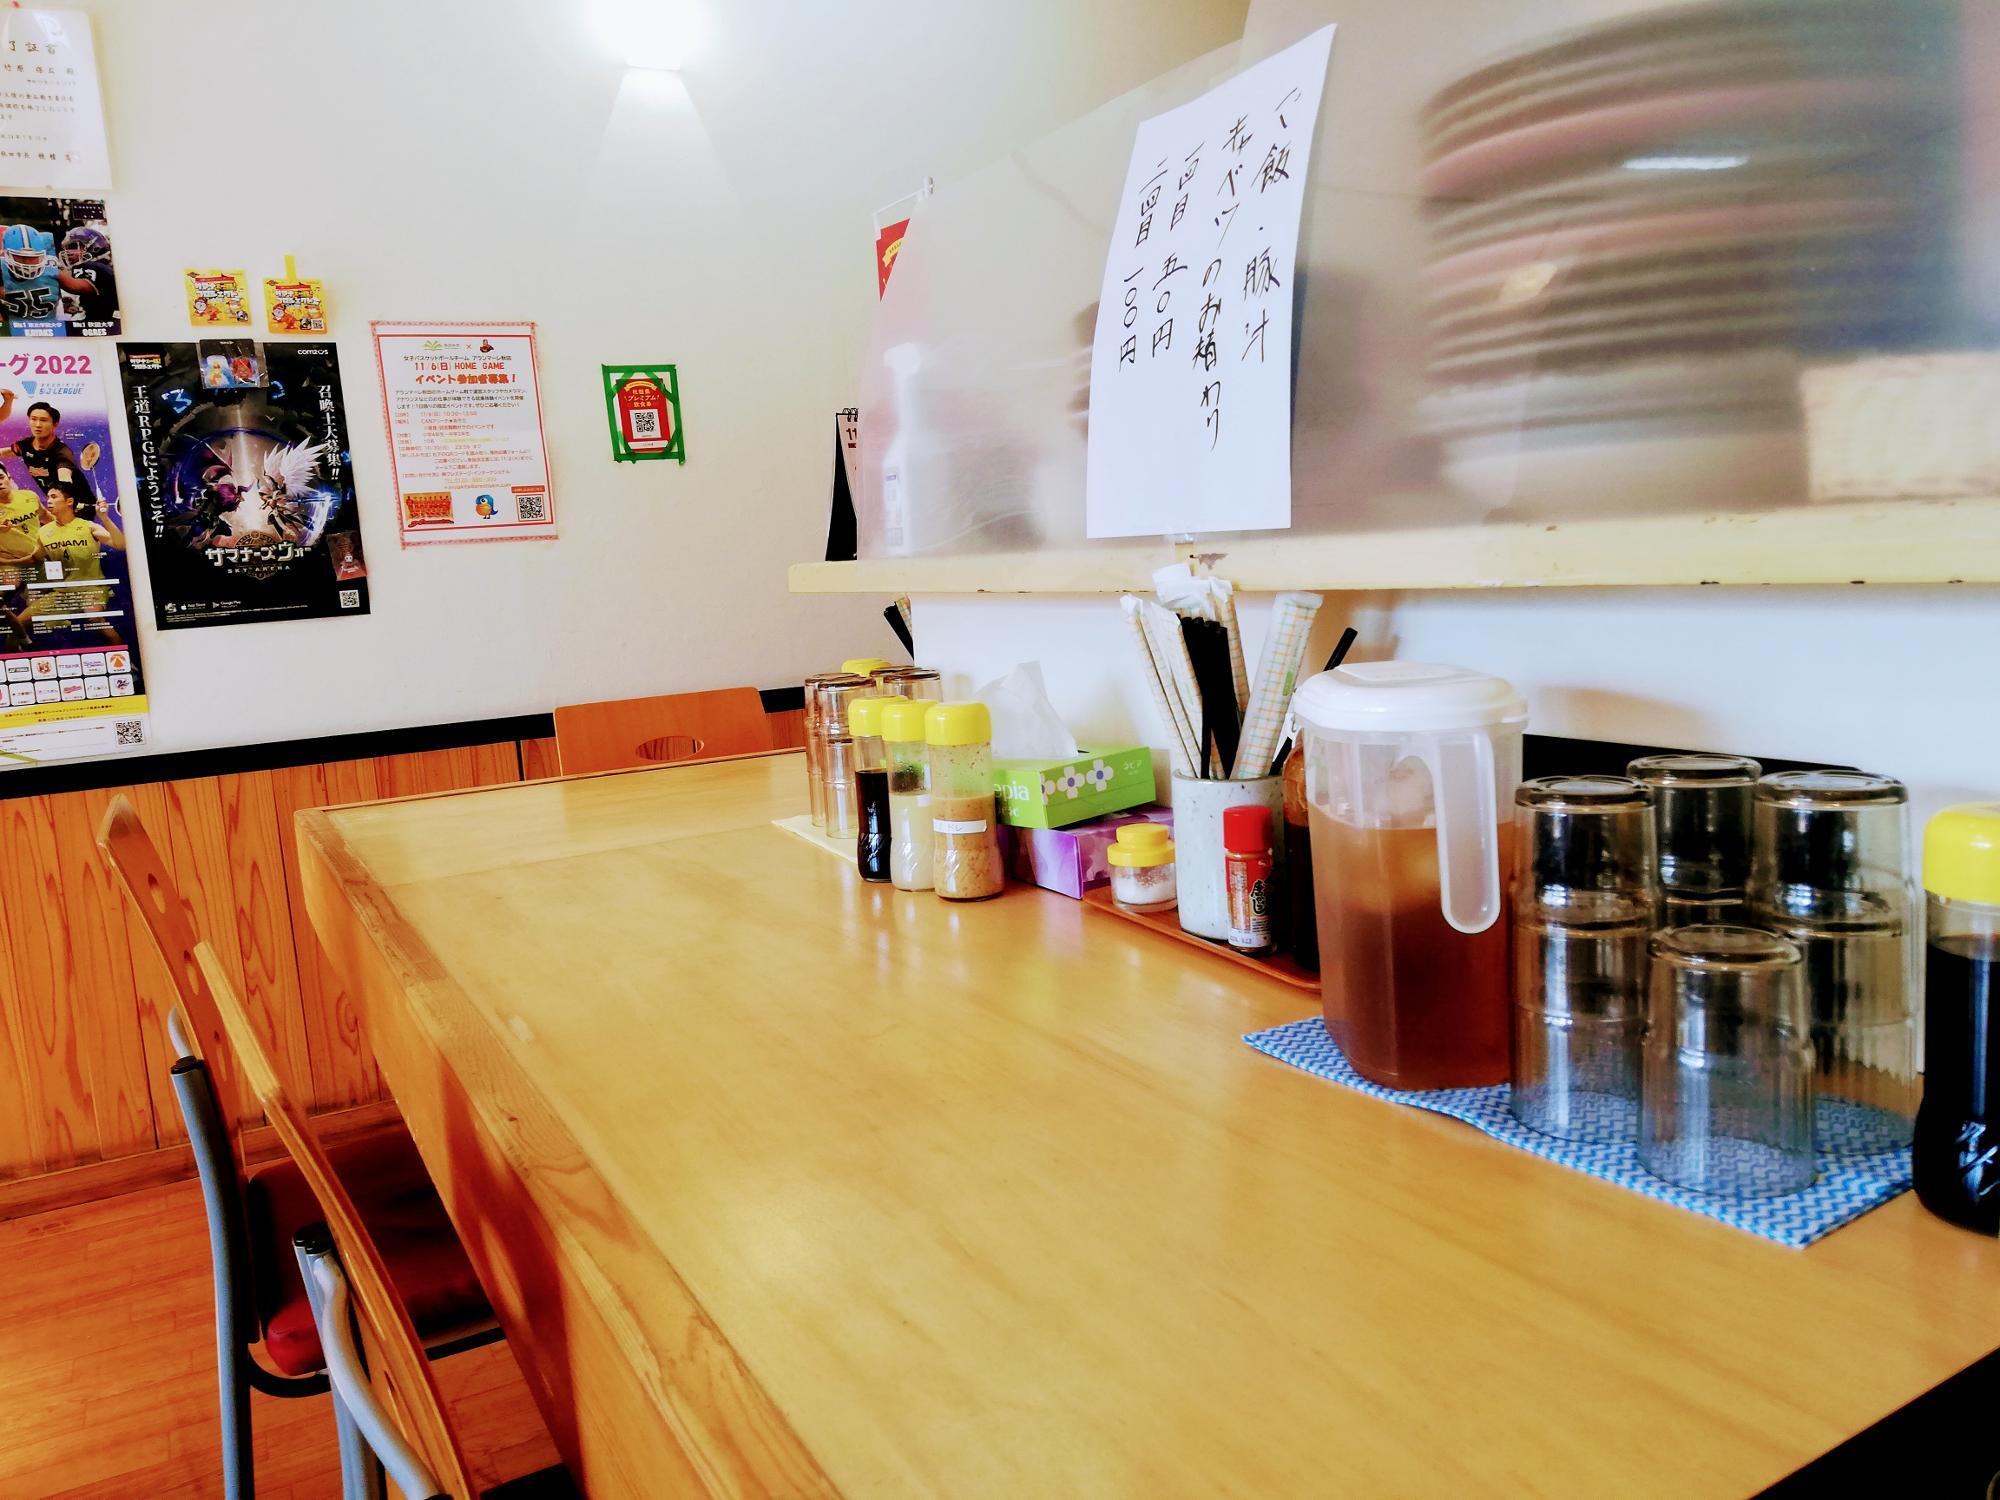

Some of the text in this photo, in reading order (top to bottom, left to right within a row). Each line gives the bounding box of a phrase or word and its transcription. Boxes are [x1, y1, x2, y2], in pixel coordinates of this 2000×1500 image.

[454, 362, 477, 370] HOME
[482, 362, 505, 370] GAME
[44, 539, 88, 551] TONAMI
[205, 541, 312, 567] サマナーズウォー
